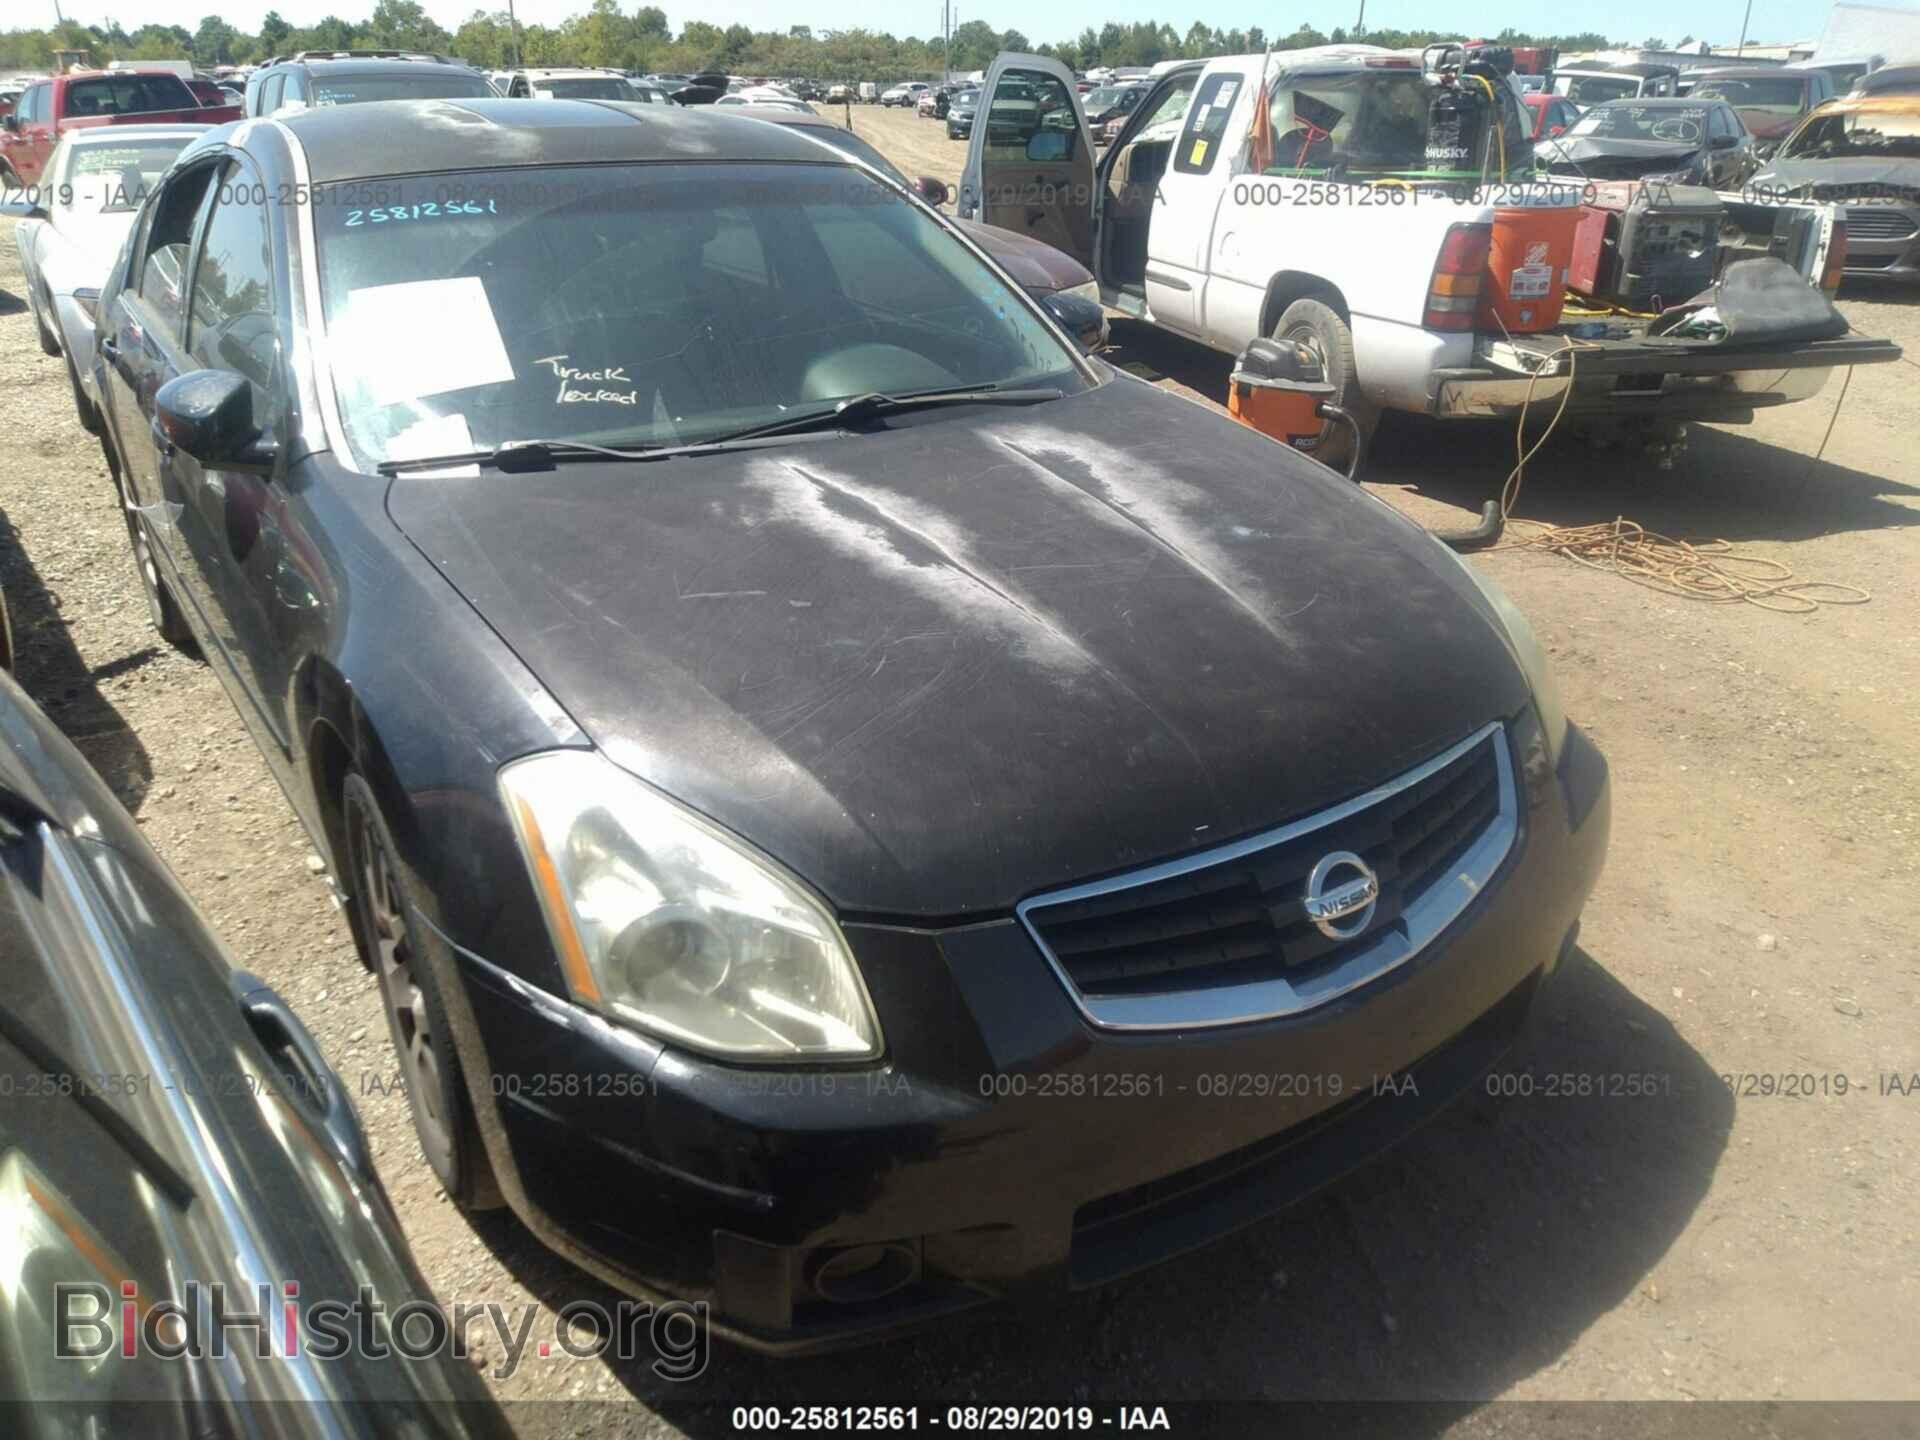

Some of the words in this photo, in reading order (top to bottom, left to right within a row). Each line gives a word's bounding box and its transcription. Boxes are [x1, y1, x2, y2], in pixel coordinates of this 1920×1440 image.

[1425, 147, 1468, 158] HUSKY
[345, 199, 497, 227] 25812561
[1319, 881, 1376, 916] NISSAN
